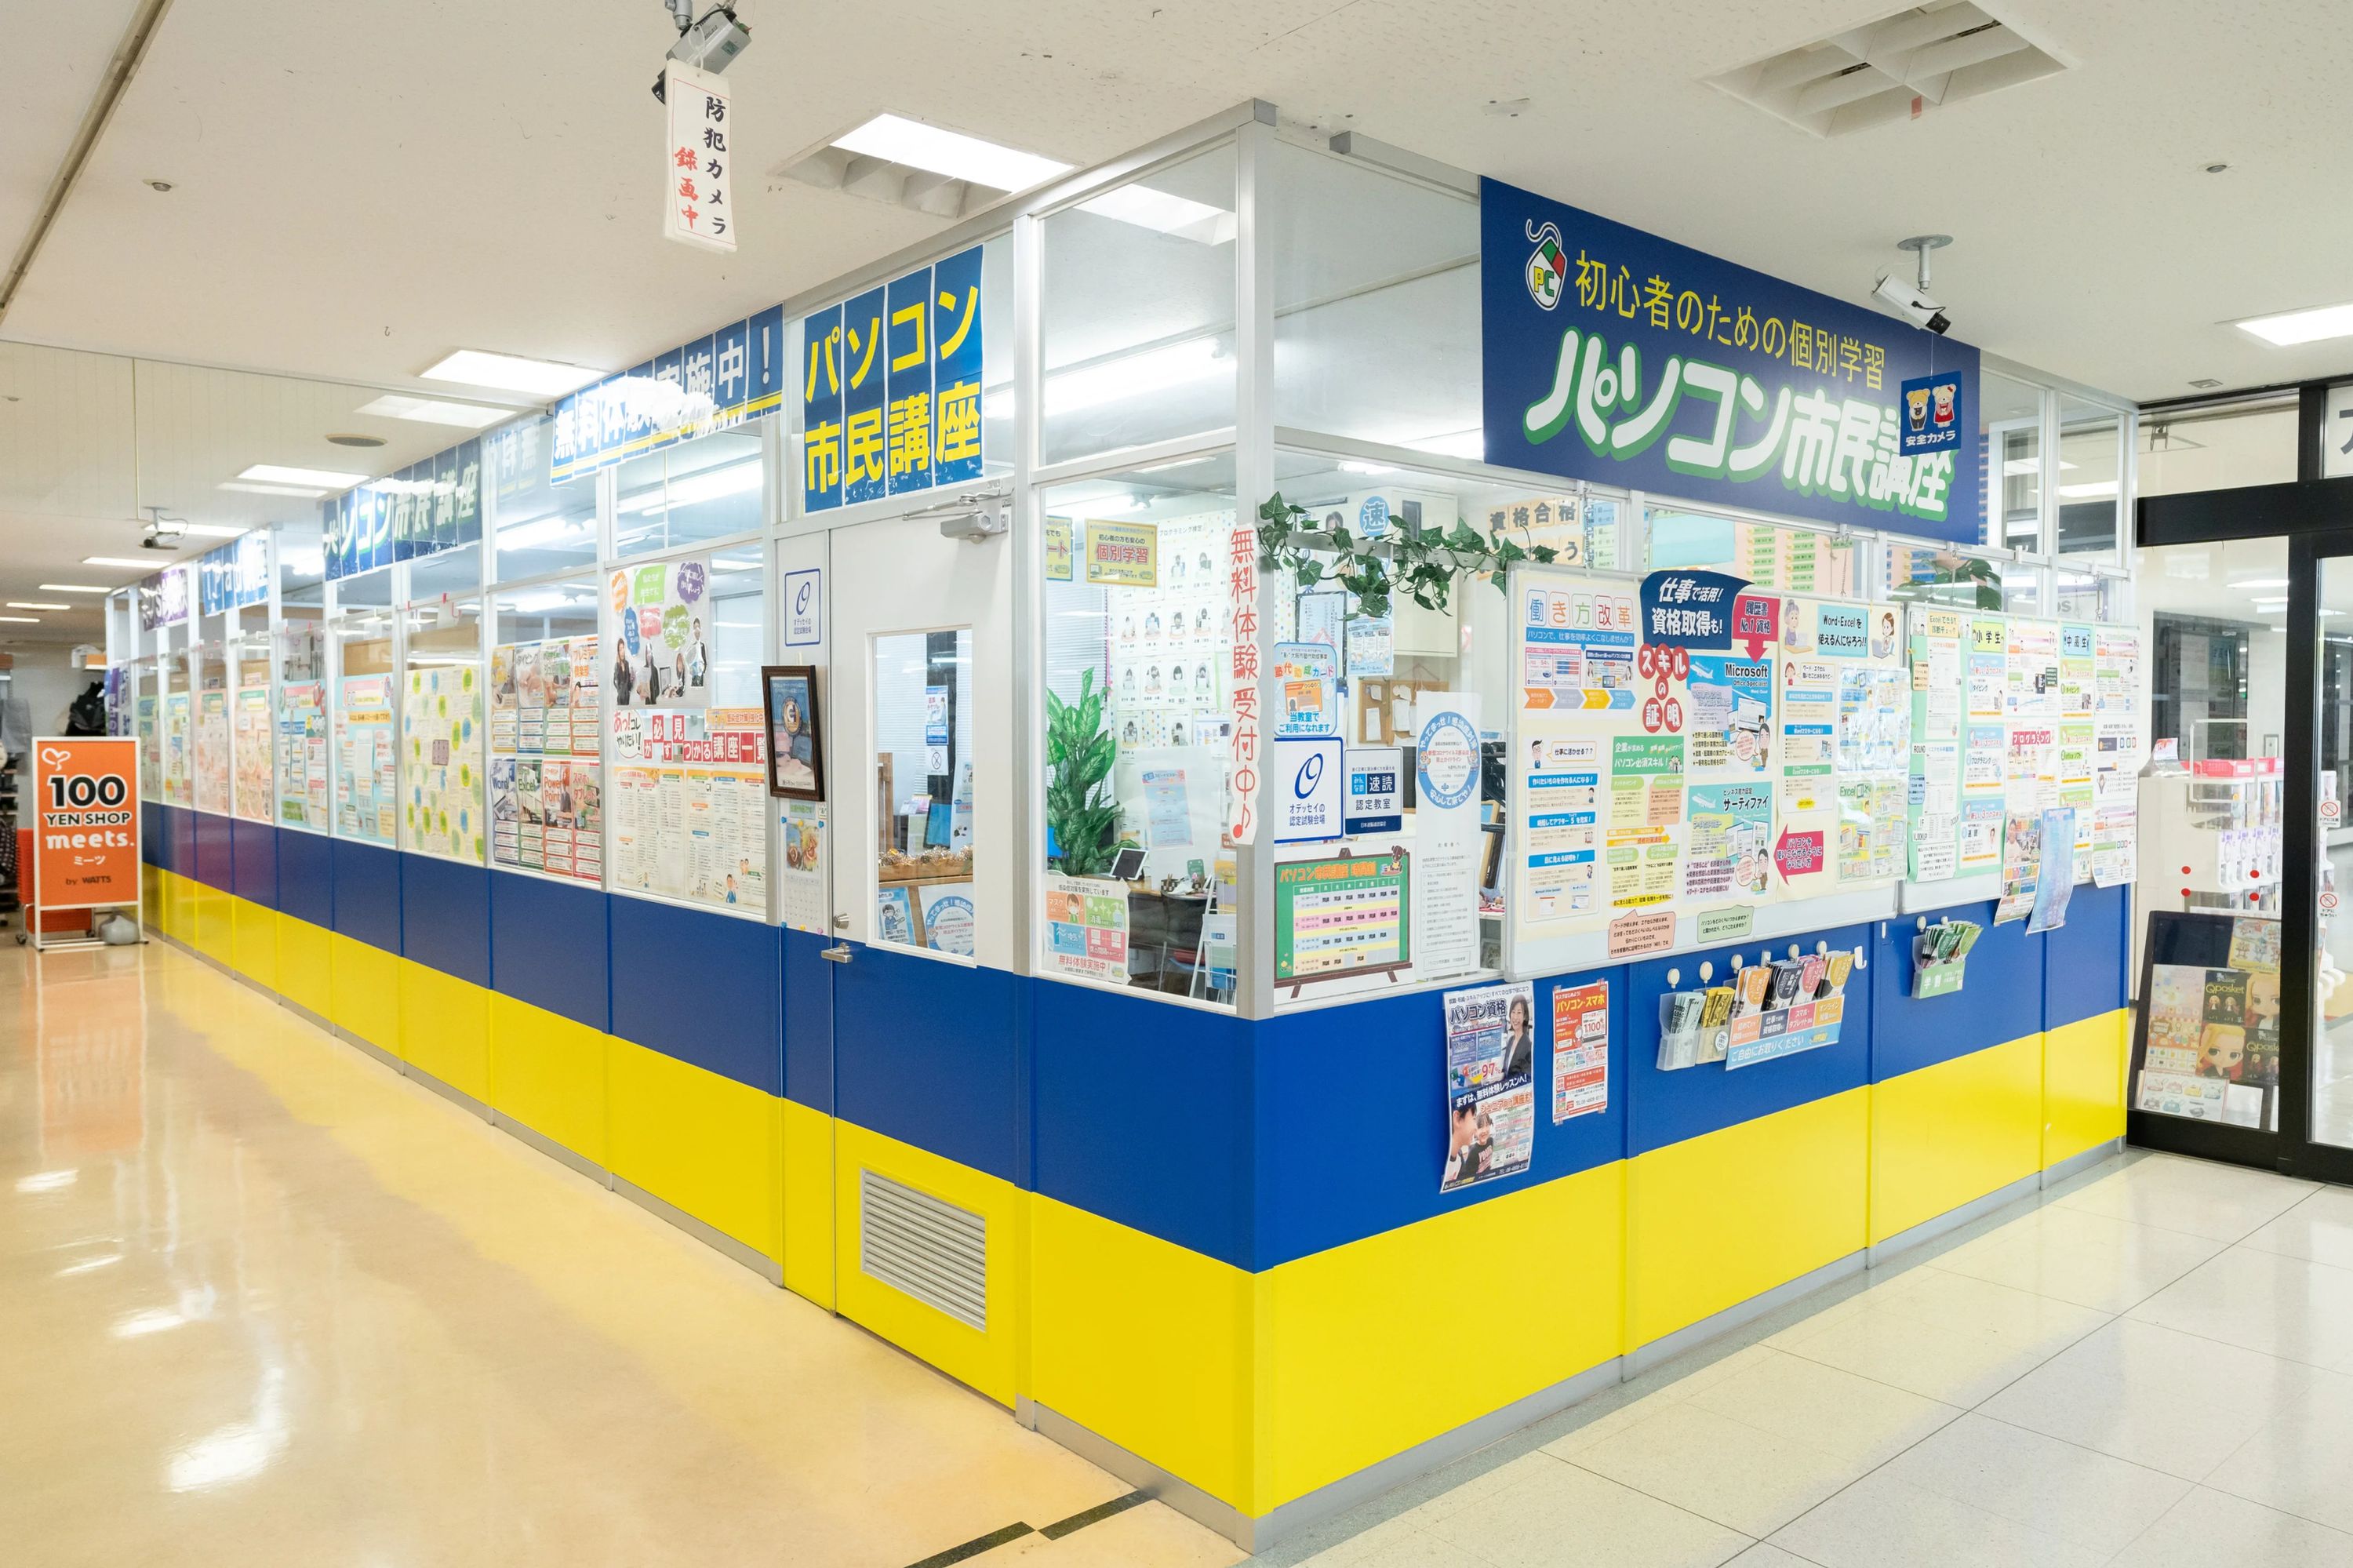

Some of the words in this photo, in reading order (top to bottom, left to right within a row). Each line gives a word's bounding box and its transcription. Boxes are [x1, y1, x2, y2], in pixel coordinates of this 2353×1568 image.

[703, 96, 726, 235] 防犯カメラ
[675, 146, 699, 230] 録画中
[1533, 265, 1555, 298] PC
[1575, 249, 1885, 391] 初心者のための個別学習
[806, 286, 978, 403] パソコン
[1526, 329, 1951, 515] パソコン市民講座
[806, 381, 980, 493] 市民講座
[1906, 431, 1956, 446] 安全カメラ
[1099, 534, 1145, 544] 初心者の方も安心の
[1096, 544, 1149, 564] 個別学習
[1659, 577, 1723, 603] 仕事で活用!
[1530, 598, 1631, 627] 働き方改革
[1745, 601, 1768, 617] 履歴書
[1652, 608, 1722, 636] 資格取得も!
[1756, 620, 1771, 634] 資格
[1818, 634, 1866, 647] 使える人になろう!!
[1976, 630, 2001, 643] 小学生
[1231, 529, 1258, 801] 無料体験受付中
[1642, 650, 1686, 674] スキル
[1726, 664, 1768, 678] Microsoft
[1289, 712, 1319, 722] 当教室で
[1646, 704, 1680, 727] 証明
[1279, 723, 1330, 733] ご利用になれます
[2013, 730, 2051, 745] プログラミング
[49, 776, 125, 807] 100
[493, 777, 509, 790] Word
[518, 779, 536, 791] Excel
[1369, 776, 1393, 792] 速読
[1839, 786, 1856, 797] Excel
[1289, 802, 1326, 814] オデッセイの
[1355, 799, 1391, 811] 認定教室
[1723, 795, 1769, 812] サーティファイ
[47, 813, 80, 825] YEN
[85, 812, 130, 824] SHOP
[1289, 814, 1326, 827] 認定試験会場
[46, 831, 135, 849] meets.
[1787, 837, 1812, 848] パソコンを
[74, 856, 105, 865] ミーツ
[82, 875, 111, 884] WATTS
[1450, 999, 1507, 1024] パソコン資格
[1556, 994, 1605, 1013] パソコン・スマホ
[1732, 1036, 1804, 1062] ご自由にお取りください
[1457, 1073, 1527, 1107] まずは、無料体験レッスンへ!
